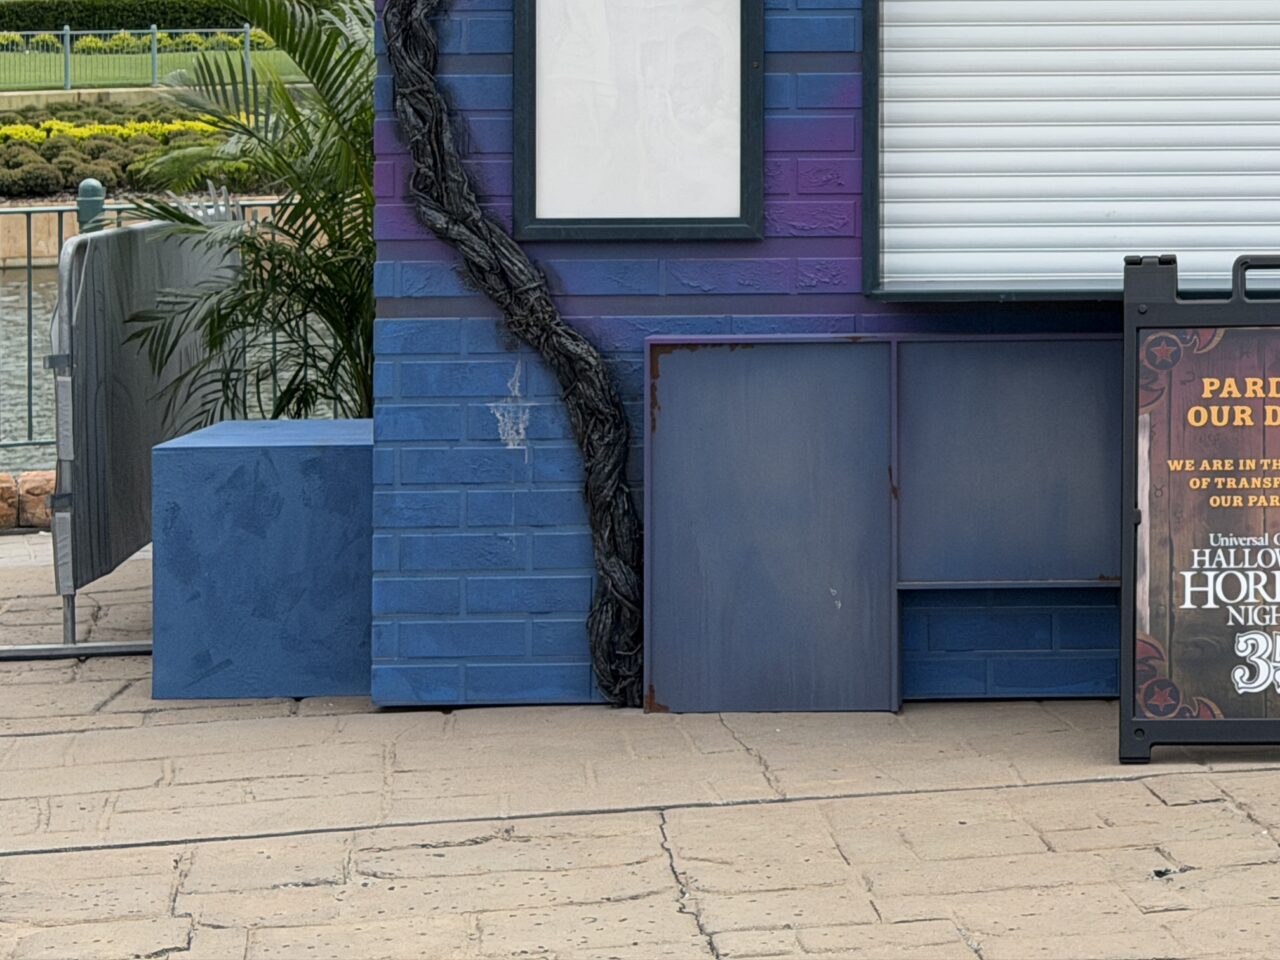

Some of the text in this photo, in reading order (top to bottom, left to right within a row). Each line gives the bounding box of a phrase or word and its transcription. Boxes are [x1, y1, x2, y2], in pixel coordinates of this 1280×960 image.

[1187, 405, 1255, 427] OUR
[1167, 459, 1195, 471] WE
[1199, 459, 1234, 471] ARE
[1238, 459, 1256, 471] IN
[1189, 477, 1211, 489] OF
[1209, 495, 1244, 507] OUR
[1209, 532, 1269, 547] Universal
